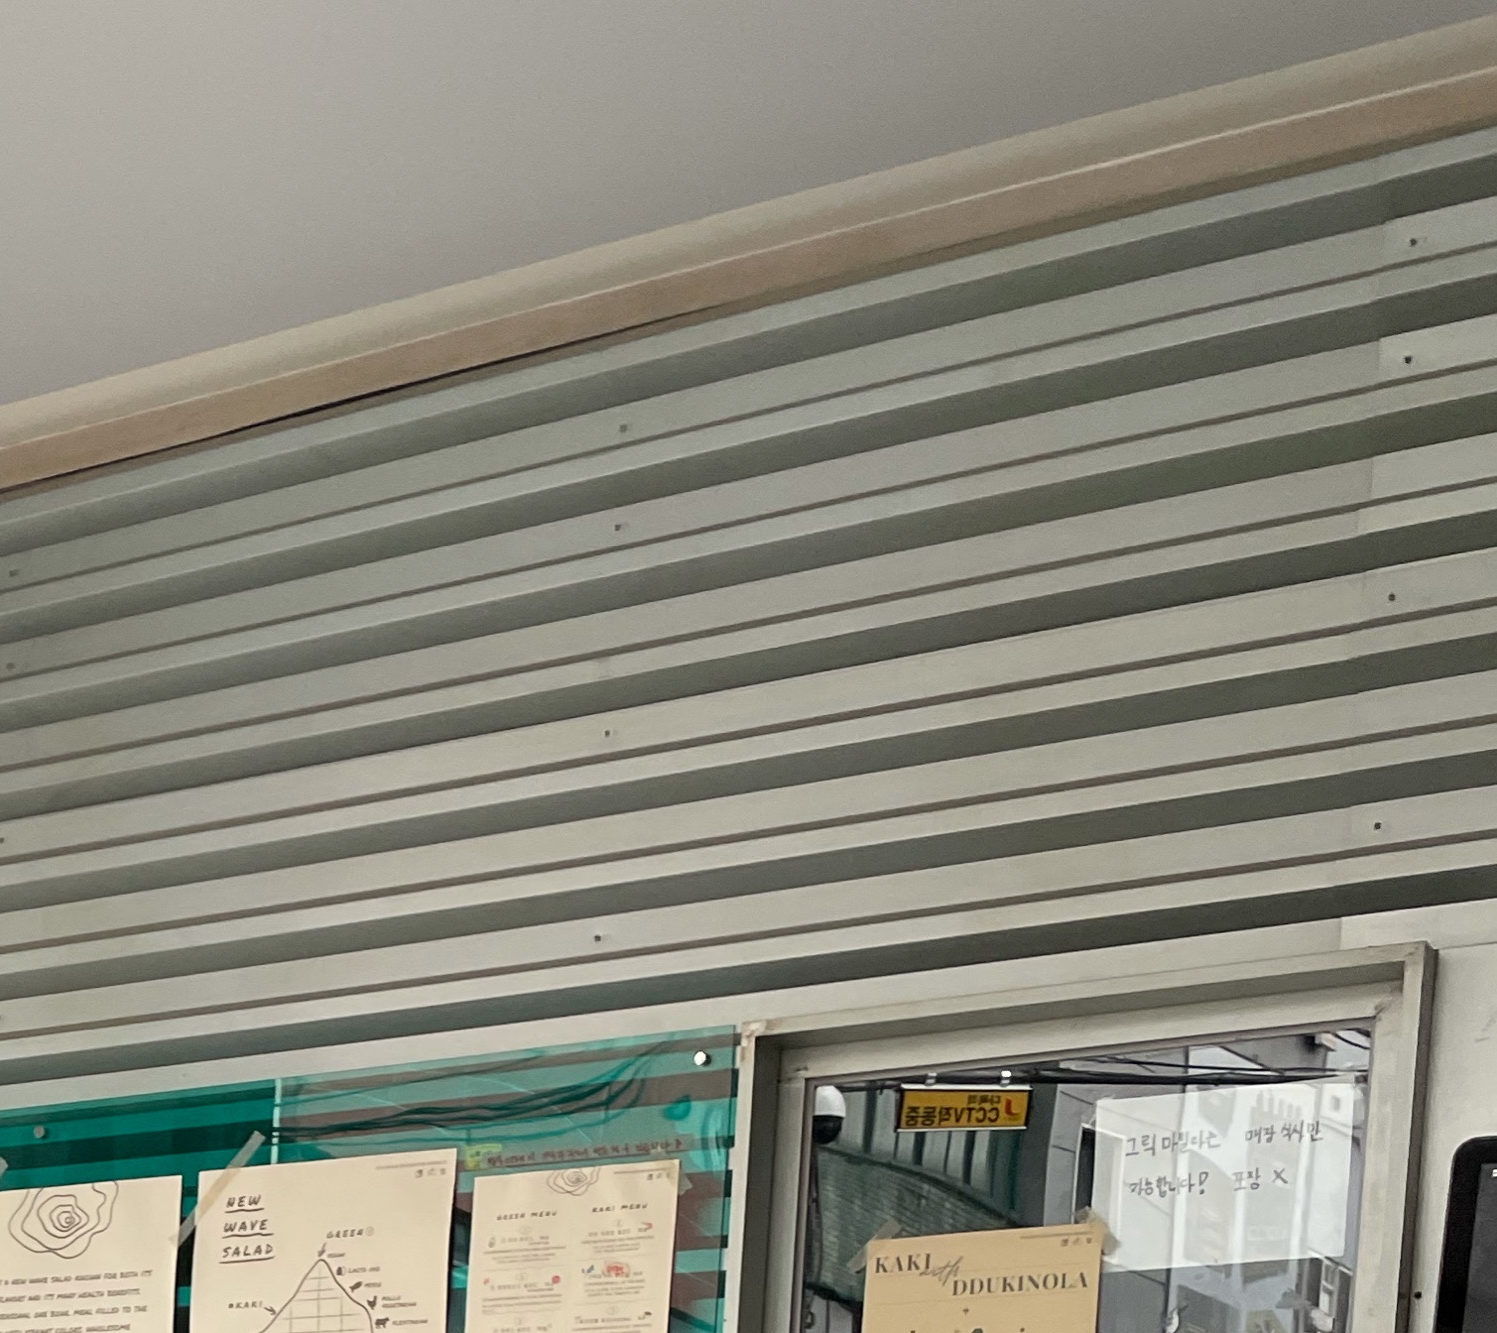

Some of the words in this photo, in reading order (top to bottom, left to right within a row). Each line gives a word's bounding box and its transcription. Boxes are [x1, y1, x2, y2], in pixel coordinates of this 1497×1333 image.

[1124, 1134, 1157, 1158] 그릭
[1244, 1124, 1277, 1145] 매장
[1231, 1167, 1261, 1192] 포장
[227, 1195, 262, 1207] NEW
[224, 1220, 268, 1232] WAVE
[327, 1229, 364, 1238] GREEN
[221, 1243, 274, 1259] SALAD
[874, 1252, 932, 1274] KAKI
[952, 1271, 1089, 1296] DDUKINOLA
